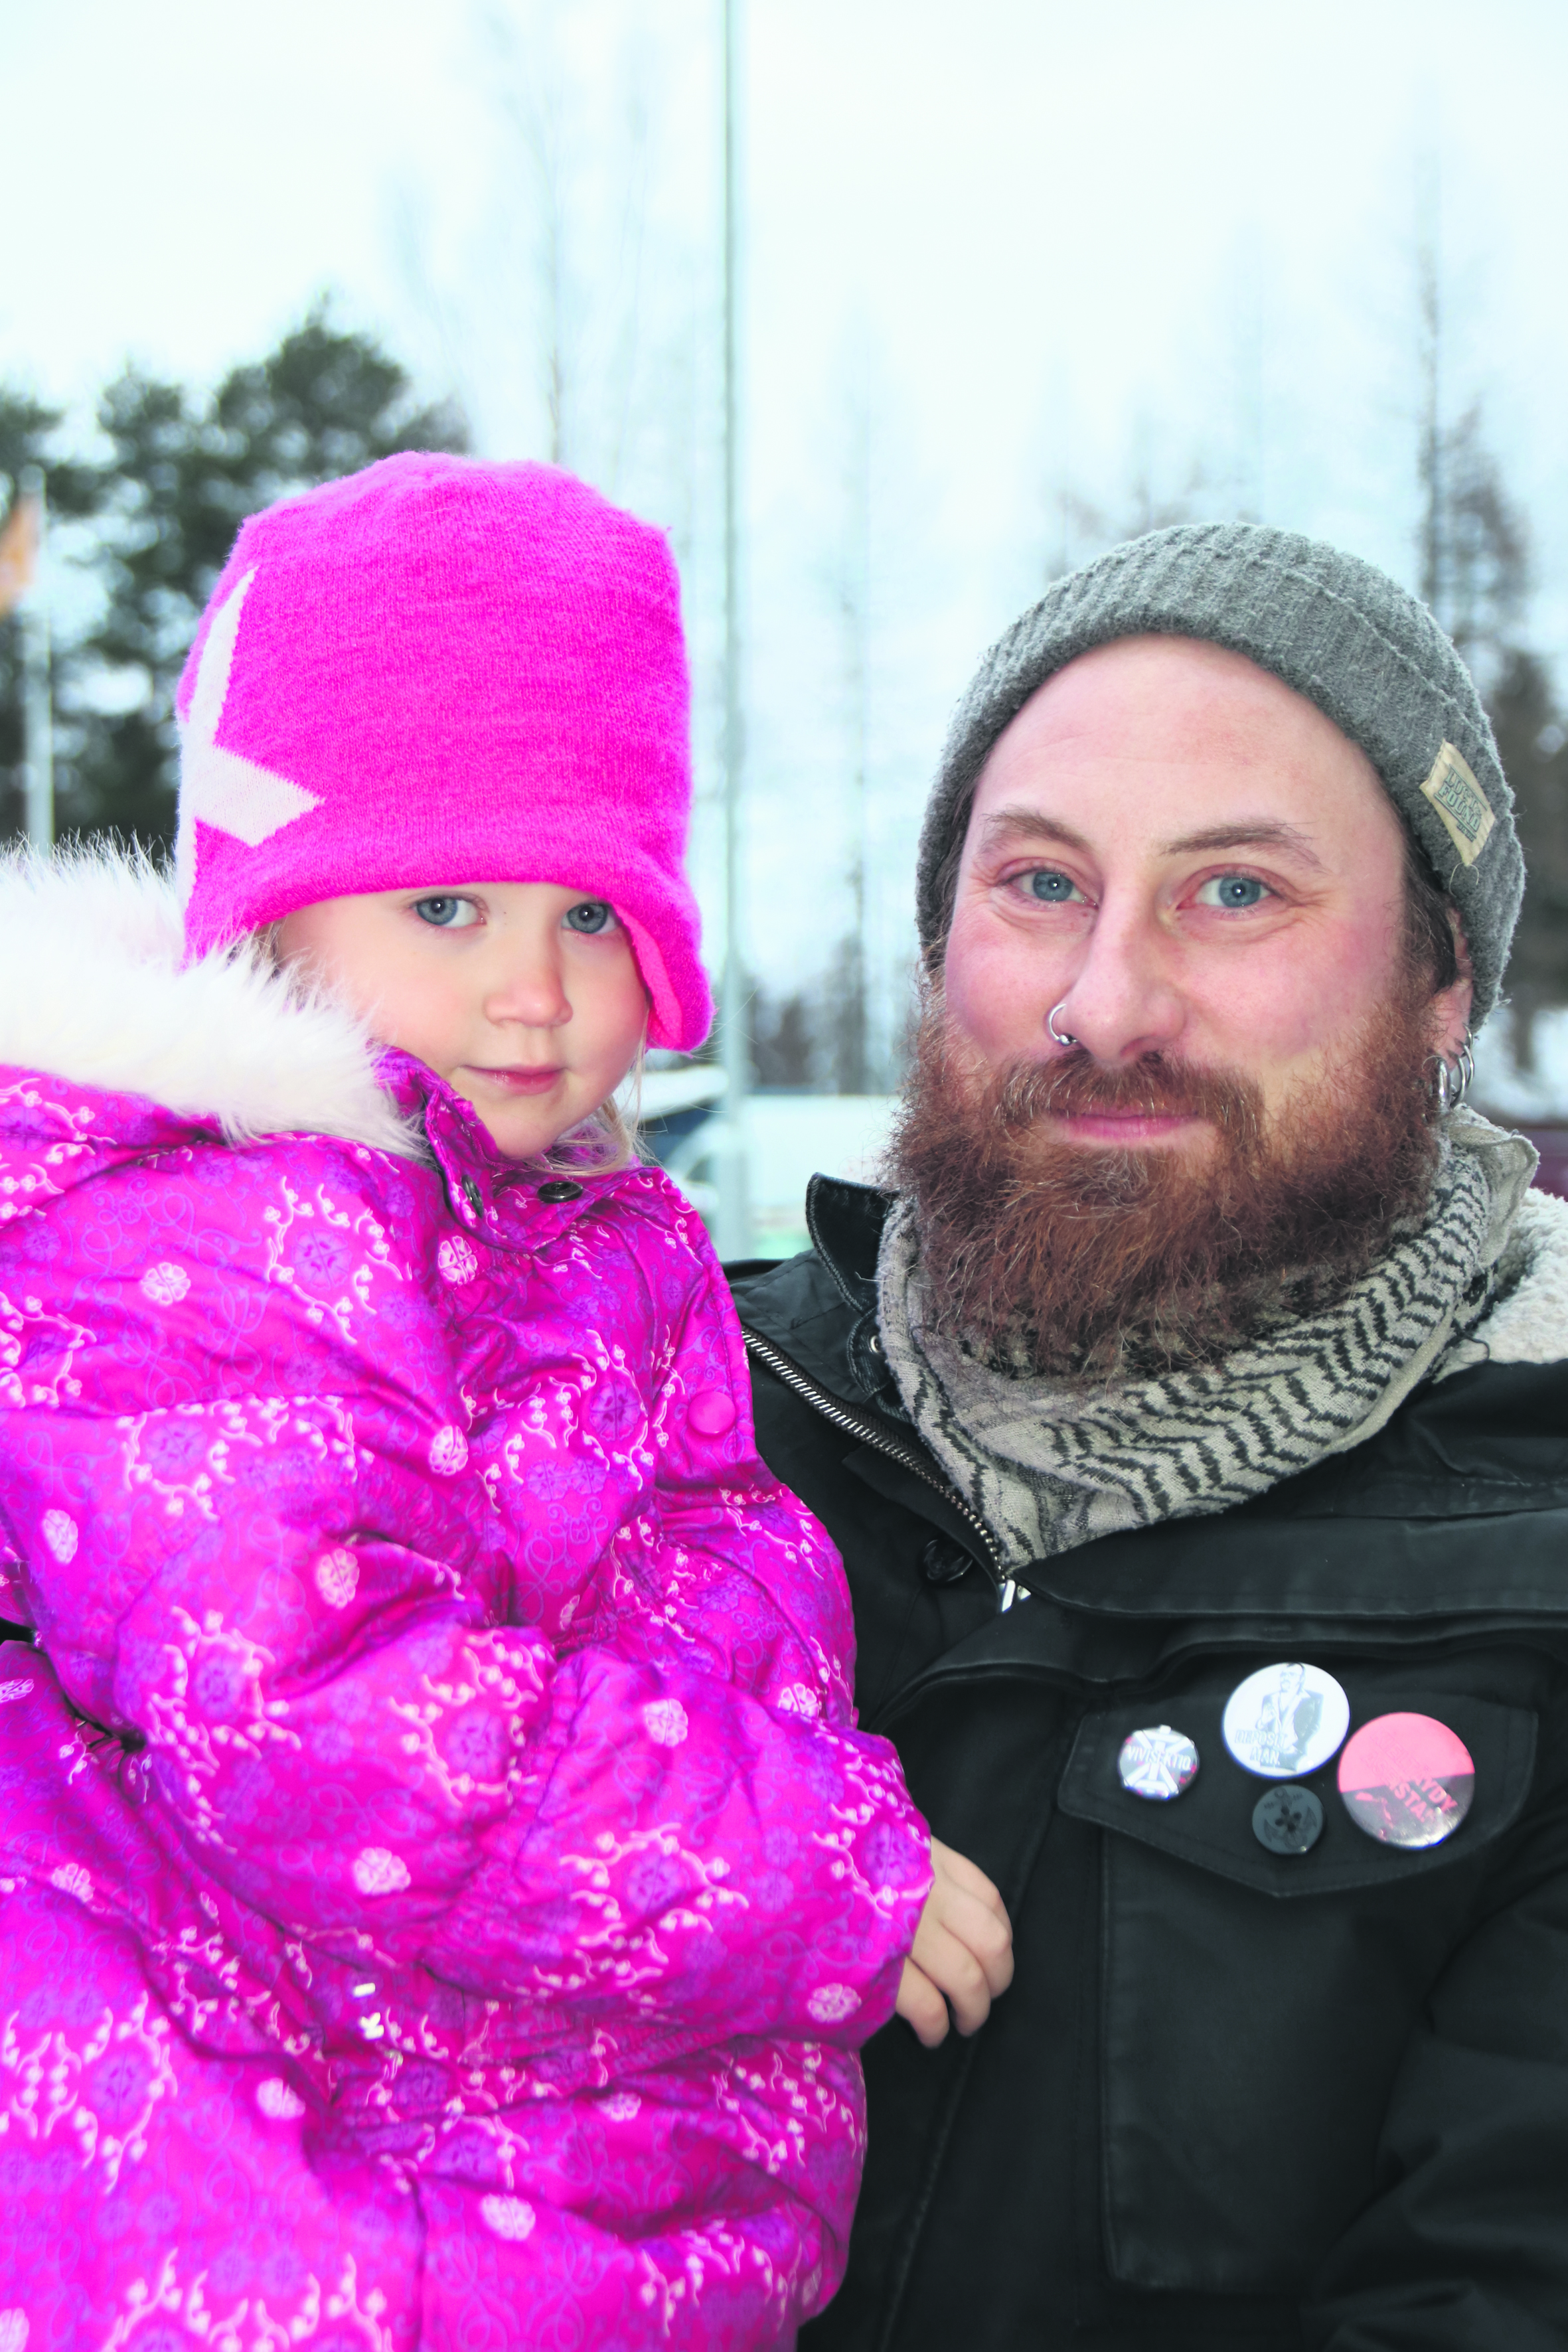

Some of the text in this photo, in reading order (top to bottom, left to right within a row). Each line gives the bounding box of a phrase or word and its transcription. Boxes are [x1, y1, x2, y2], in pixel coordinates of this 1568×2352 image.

[1438, 782, 1480, 832] FOUND
[1445, 769, 1478, 809] LOST
[1235, 1730, 1285, 1748] DEPOSIT
